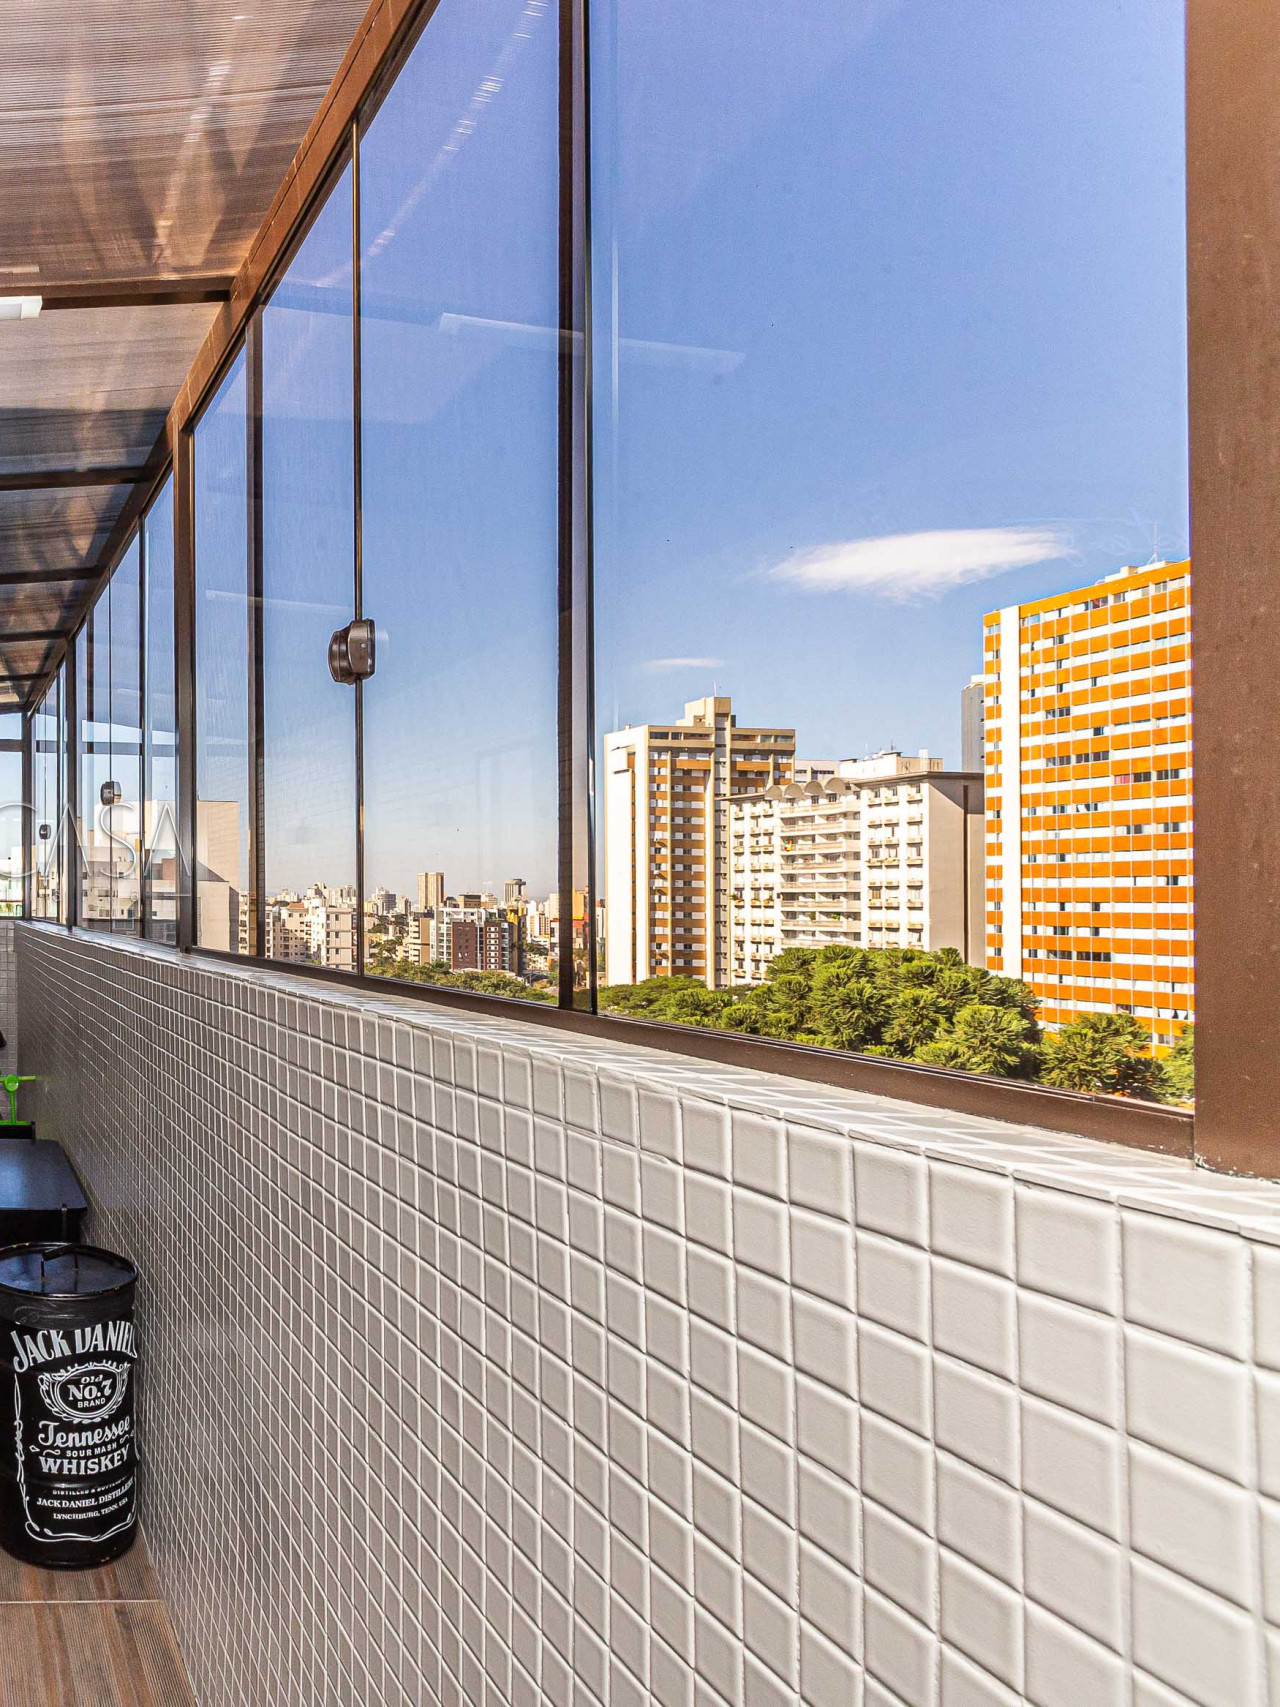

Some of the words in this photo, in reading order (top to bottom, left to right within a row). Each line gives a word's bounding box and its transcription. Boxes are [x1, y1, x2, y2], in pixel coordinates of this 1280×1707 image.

[10, 1329, 72, 1373] JACK
[77, 1397, 106, 1409] BRAND
[38, 1416, 130, 1448] Tennessee
[39, 1443, 130, 1475] WHISKEY
[66, 1449, 92, 1457] SOUR
[94, 1442, 117, 1455] MASH
[37, 1498, 61, 1508] JACK
[62, 1498, 97, 1509] DANIEL
